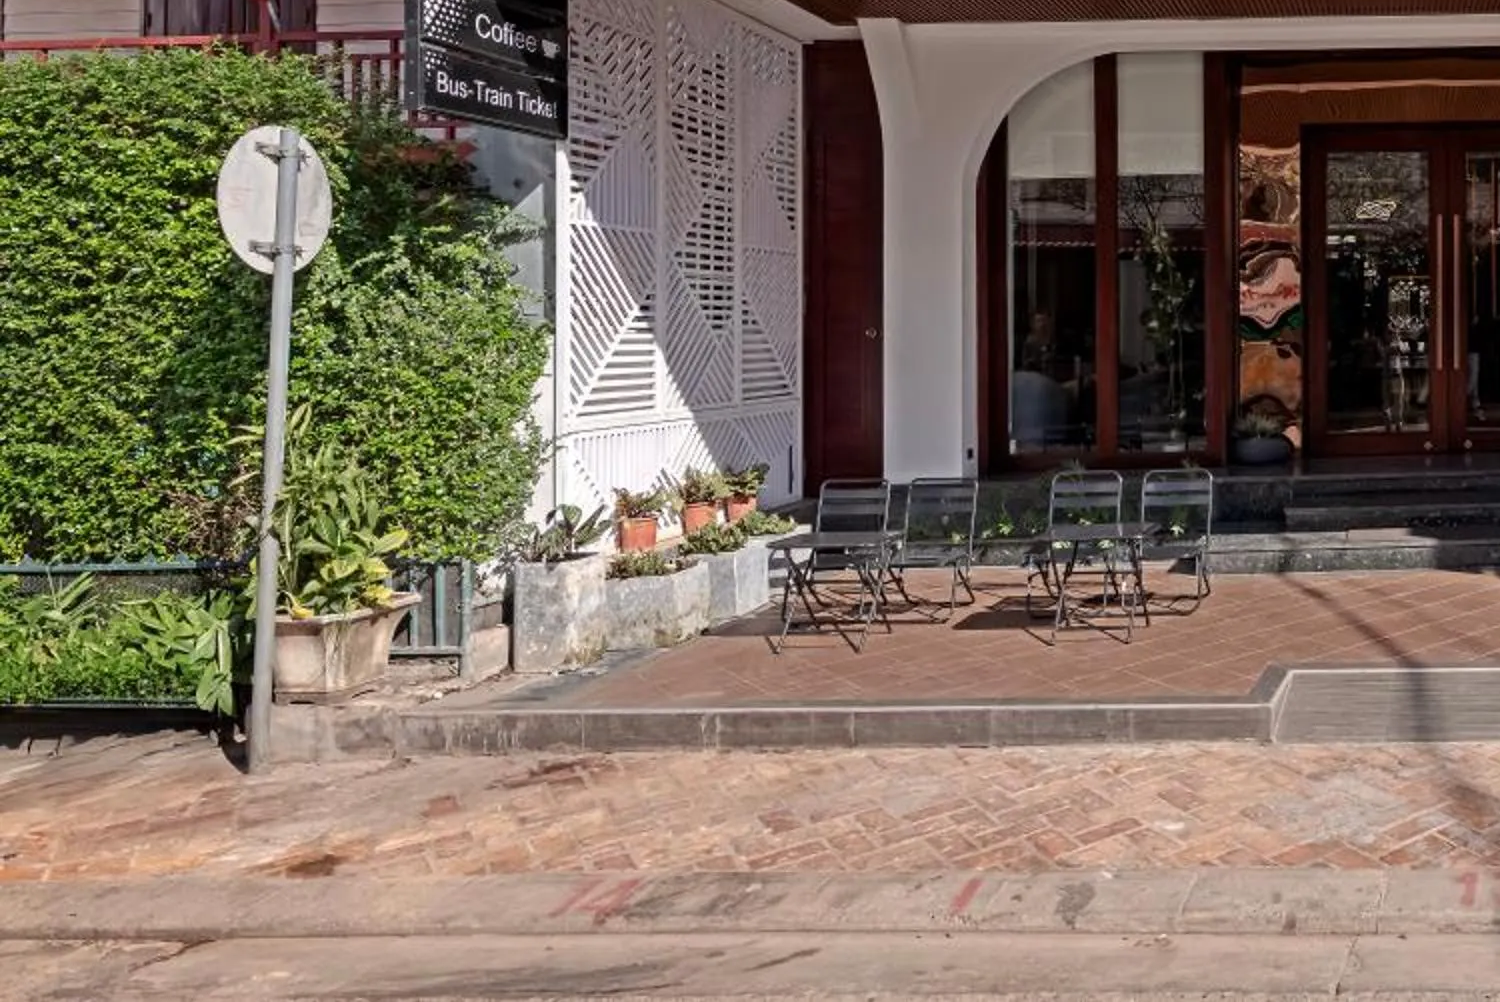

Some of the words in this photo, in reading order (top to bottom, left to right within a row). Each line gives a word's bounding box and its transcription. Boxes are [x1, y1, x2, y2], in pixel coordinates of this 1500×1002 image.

[474, 12, 539, 54] Coffee
[435, 69, 513, 110] Bus-Train
[516, 91, 559, 120] Ticket
